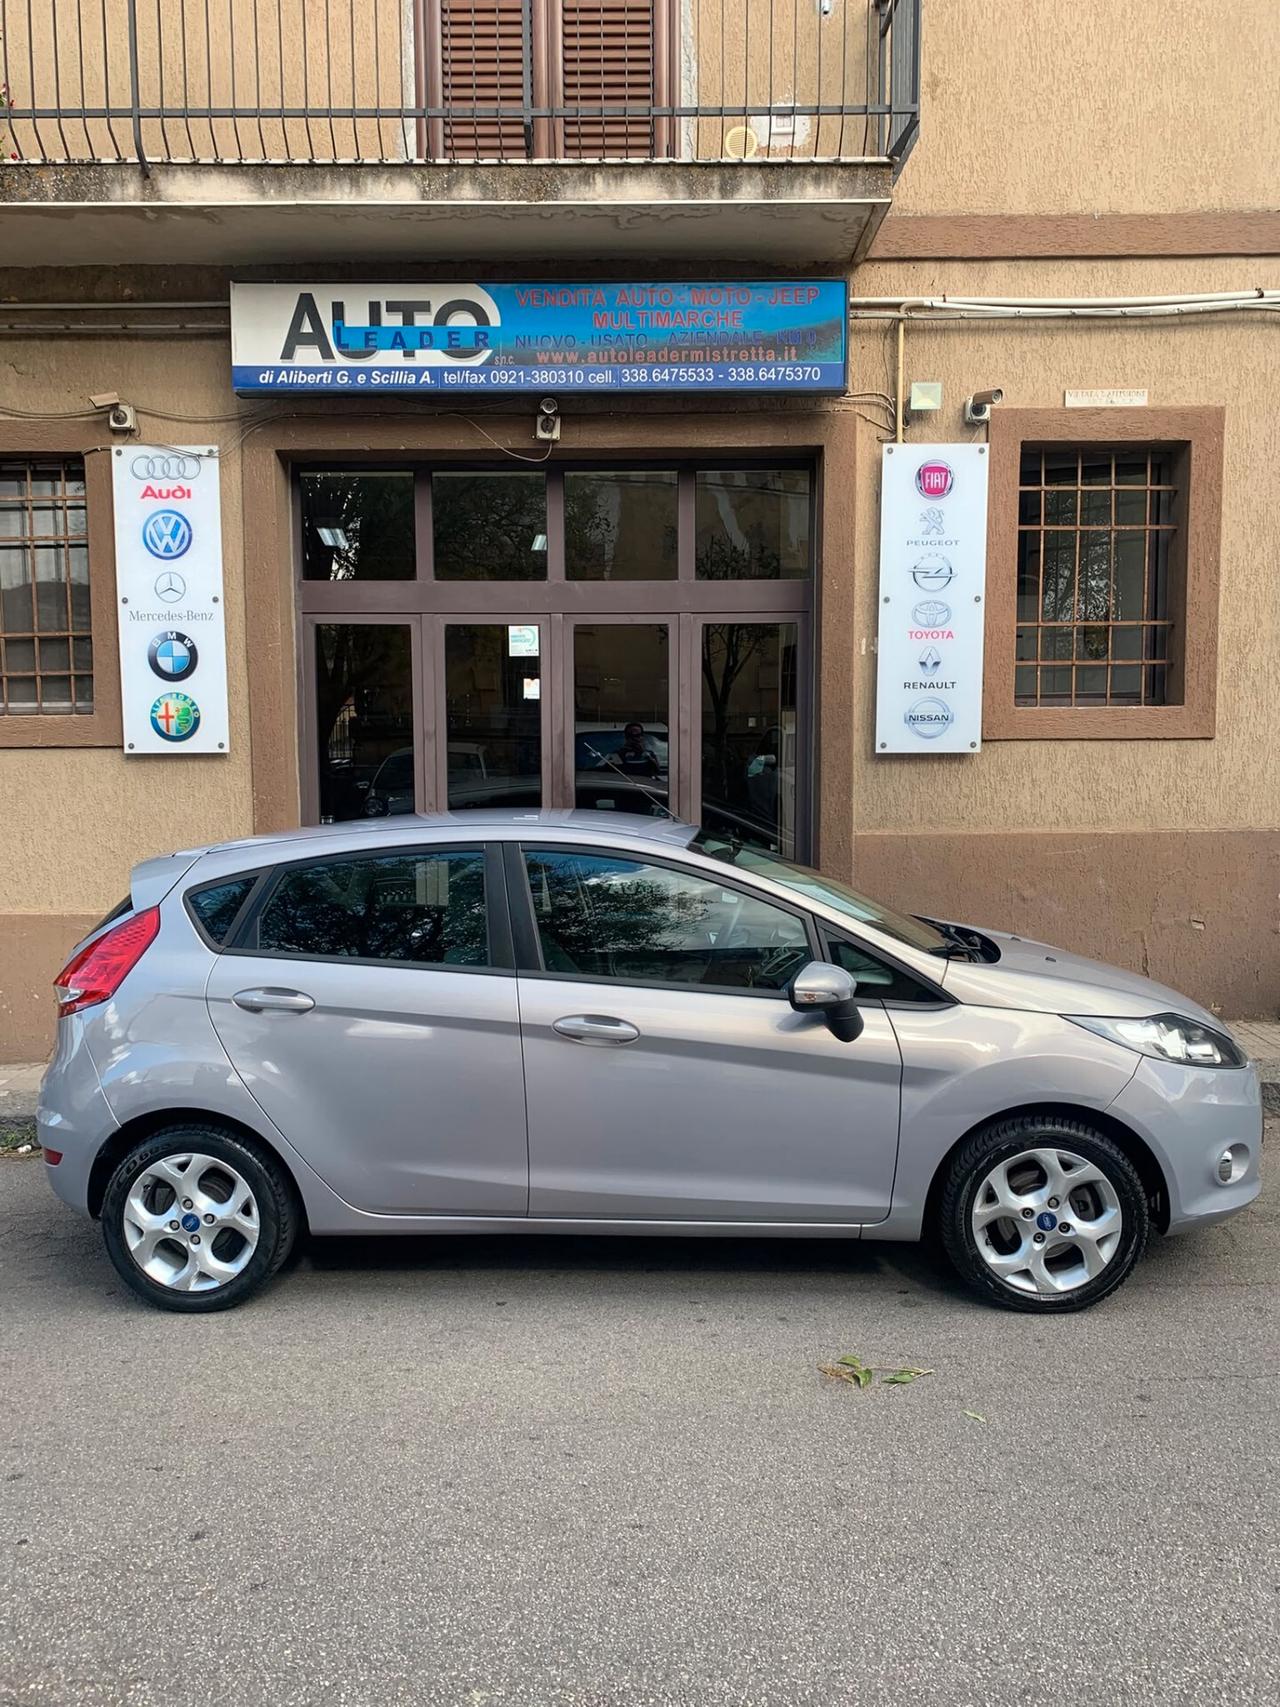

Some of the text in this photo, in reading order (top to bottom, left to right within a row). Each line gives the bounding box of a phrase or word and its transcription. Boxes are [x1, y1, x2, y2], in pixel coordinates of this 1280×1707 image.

[515, 288, 607, 307] VENDITA
[616, 288, 673, 307] AUTO
[691, 287, 750, 306] MOTO
[768, 287, 819, 305] JEEP
[280, 292, 491, 360] AUTO
[592, 310, 743, 329] MULTIMARCHE
[335, 326, 490, 350] LEADER
[515, 334, 576, 349] NUOVO
[591, 333, 648, 348] USATO
[668, 330, 762, 346] AZIENDALE
[536, 346, 798, 364] www.autoleadermistretta.it
[259, 370, 273, 384] di
[276, 370, 333, 384] Aliberti
[337, 370, 352, 384] G.
[357, 374, 366, 384] e
[370, 370, 416, 384] Scillia
[418, 370, 435, 384] A.
[443, 369, 488, 385] tel/fax
[490, 370, 584, 384] 0921-380310
[588, 369, 616, 384] cell.
[621, 367, 714, 382] 338.6475533
[728, 366, 821, 382] 338.6475370
[924, 472, 946, 489] FIAT
[140, 485, 192, 500] Audi
[129, 610, 214, 622] Mercedes-Benz
[151, 631, 194, 648] BMW
[908, 630, 954, 640] TOYOTA
[903, 681, 957, 690] RENAULT
[908, 714, 949, 722] NISSAN
